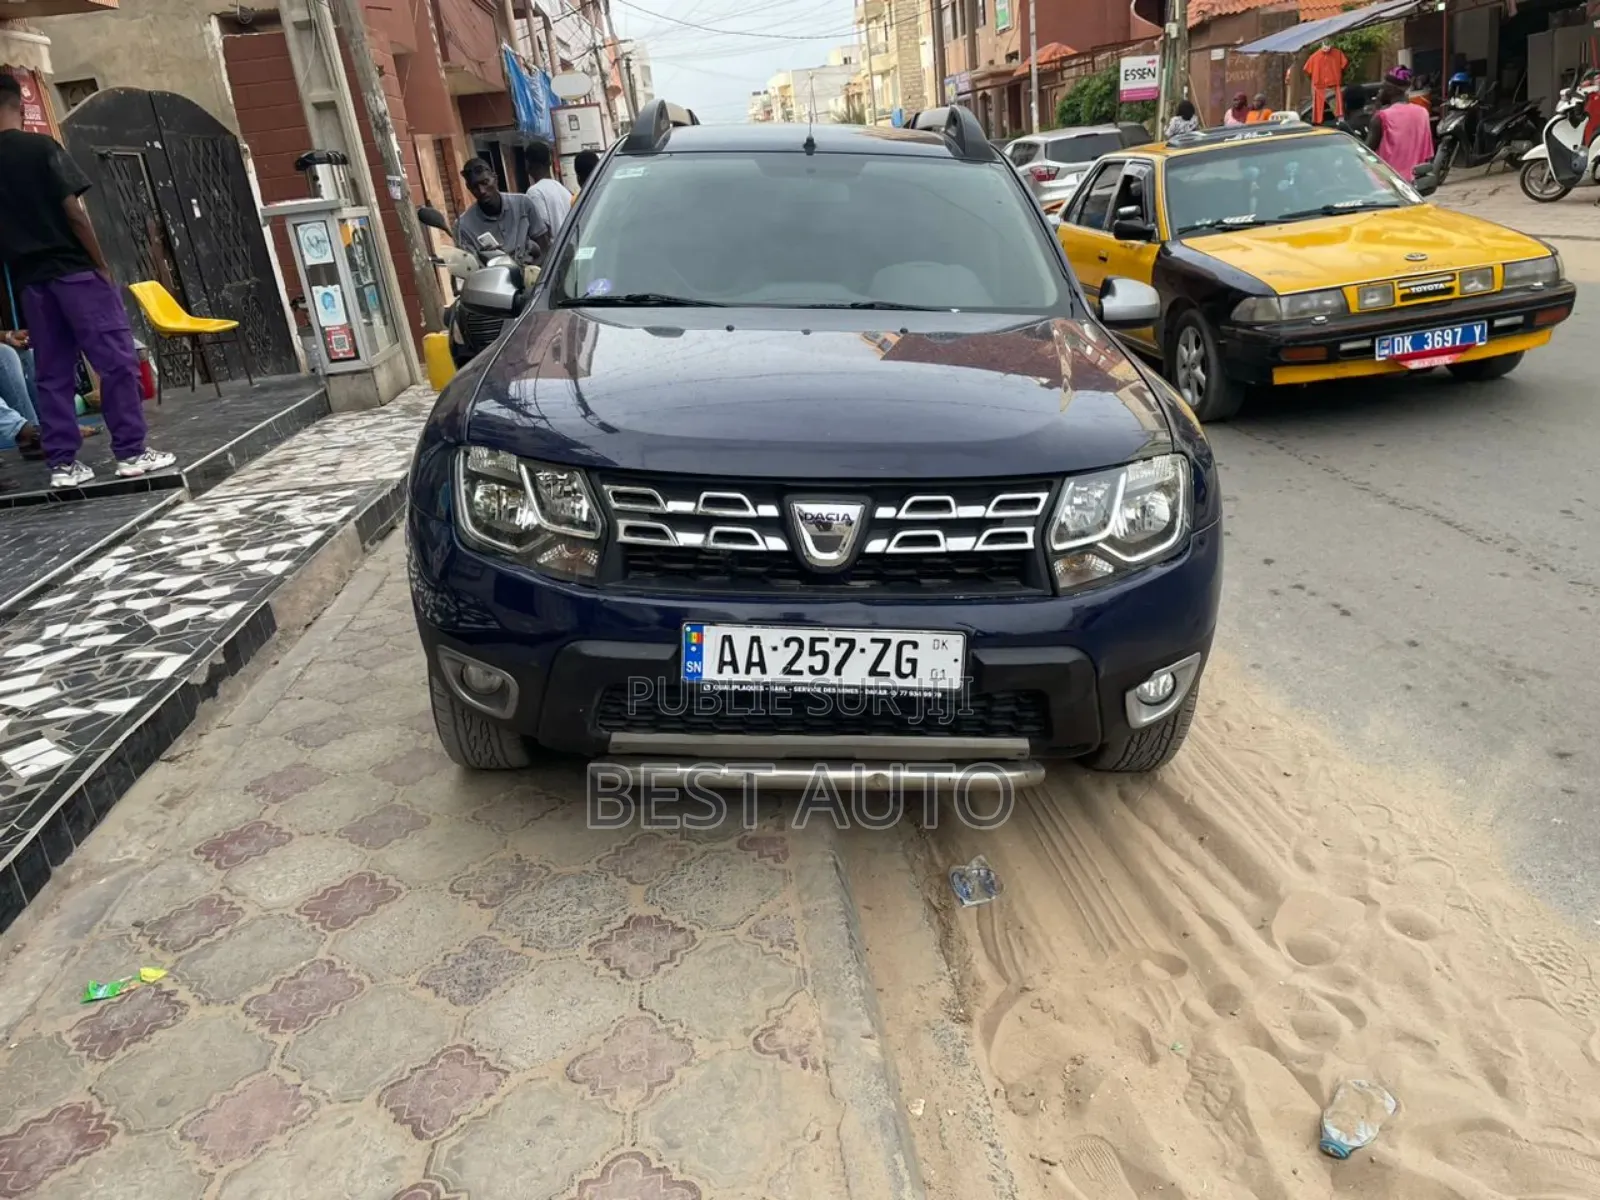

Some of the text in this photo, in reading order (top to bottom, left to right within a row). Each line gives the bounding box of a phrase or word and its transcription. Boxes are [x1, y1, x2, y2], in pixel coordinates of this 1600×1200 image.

[1124, 67, 1156, 81] ESSEN
[1410, 283, 1445, 294] TOYOTA
[1394, 335, 1413, 354] DK
[1423, 327, 1462, 351] 3697
[1473, 324, 1482, 343] Y
[804, 512, 852, 522] DACIA
[932, 638, 949, 651] DK
[686, 661, 702, 673] SN
